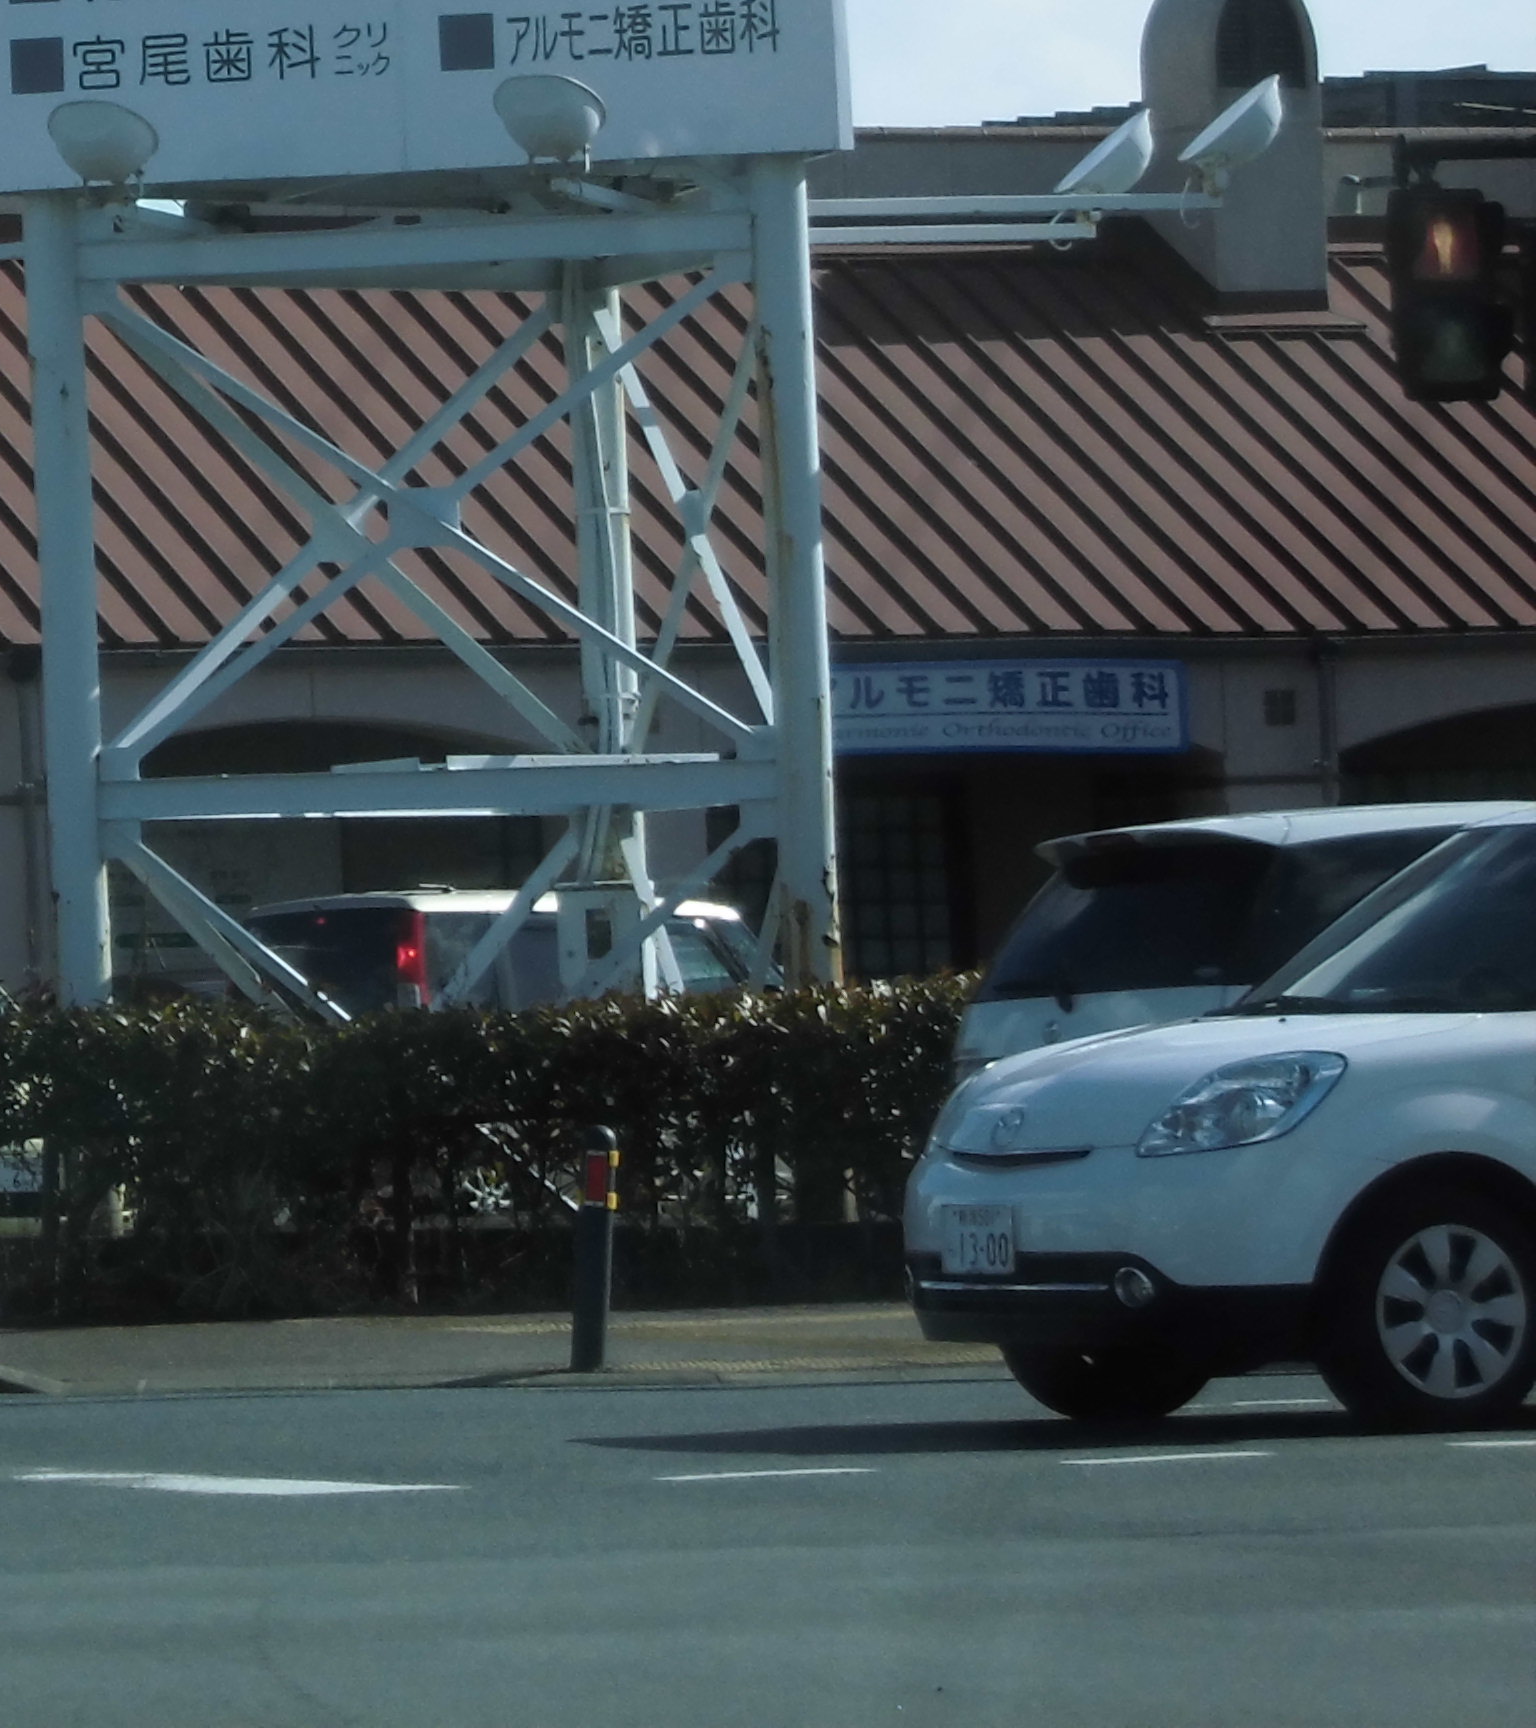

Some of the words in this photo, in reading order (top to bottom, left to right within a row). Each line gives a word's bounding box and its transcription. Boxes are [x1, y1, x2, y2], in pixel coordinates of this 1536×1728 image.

[72, 24, 321, 91] 宮尾歯科
[830, 670, 1170, 710] ルモニ矯正歯科
[1100, 721, 1173, 745] Office
